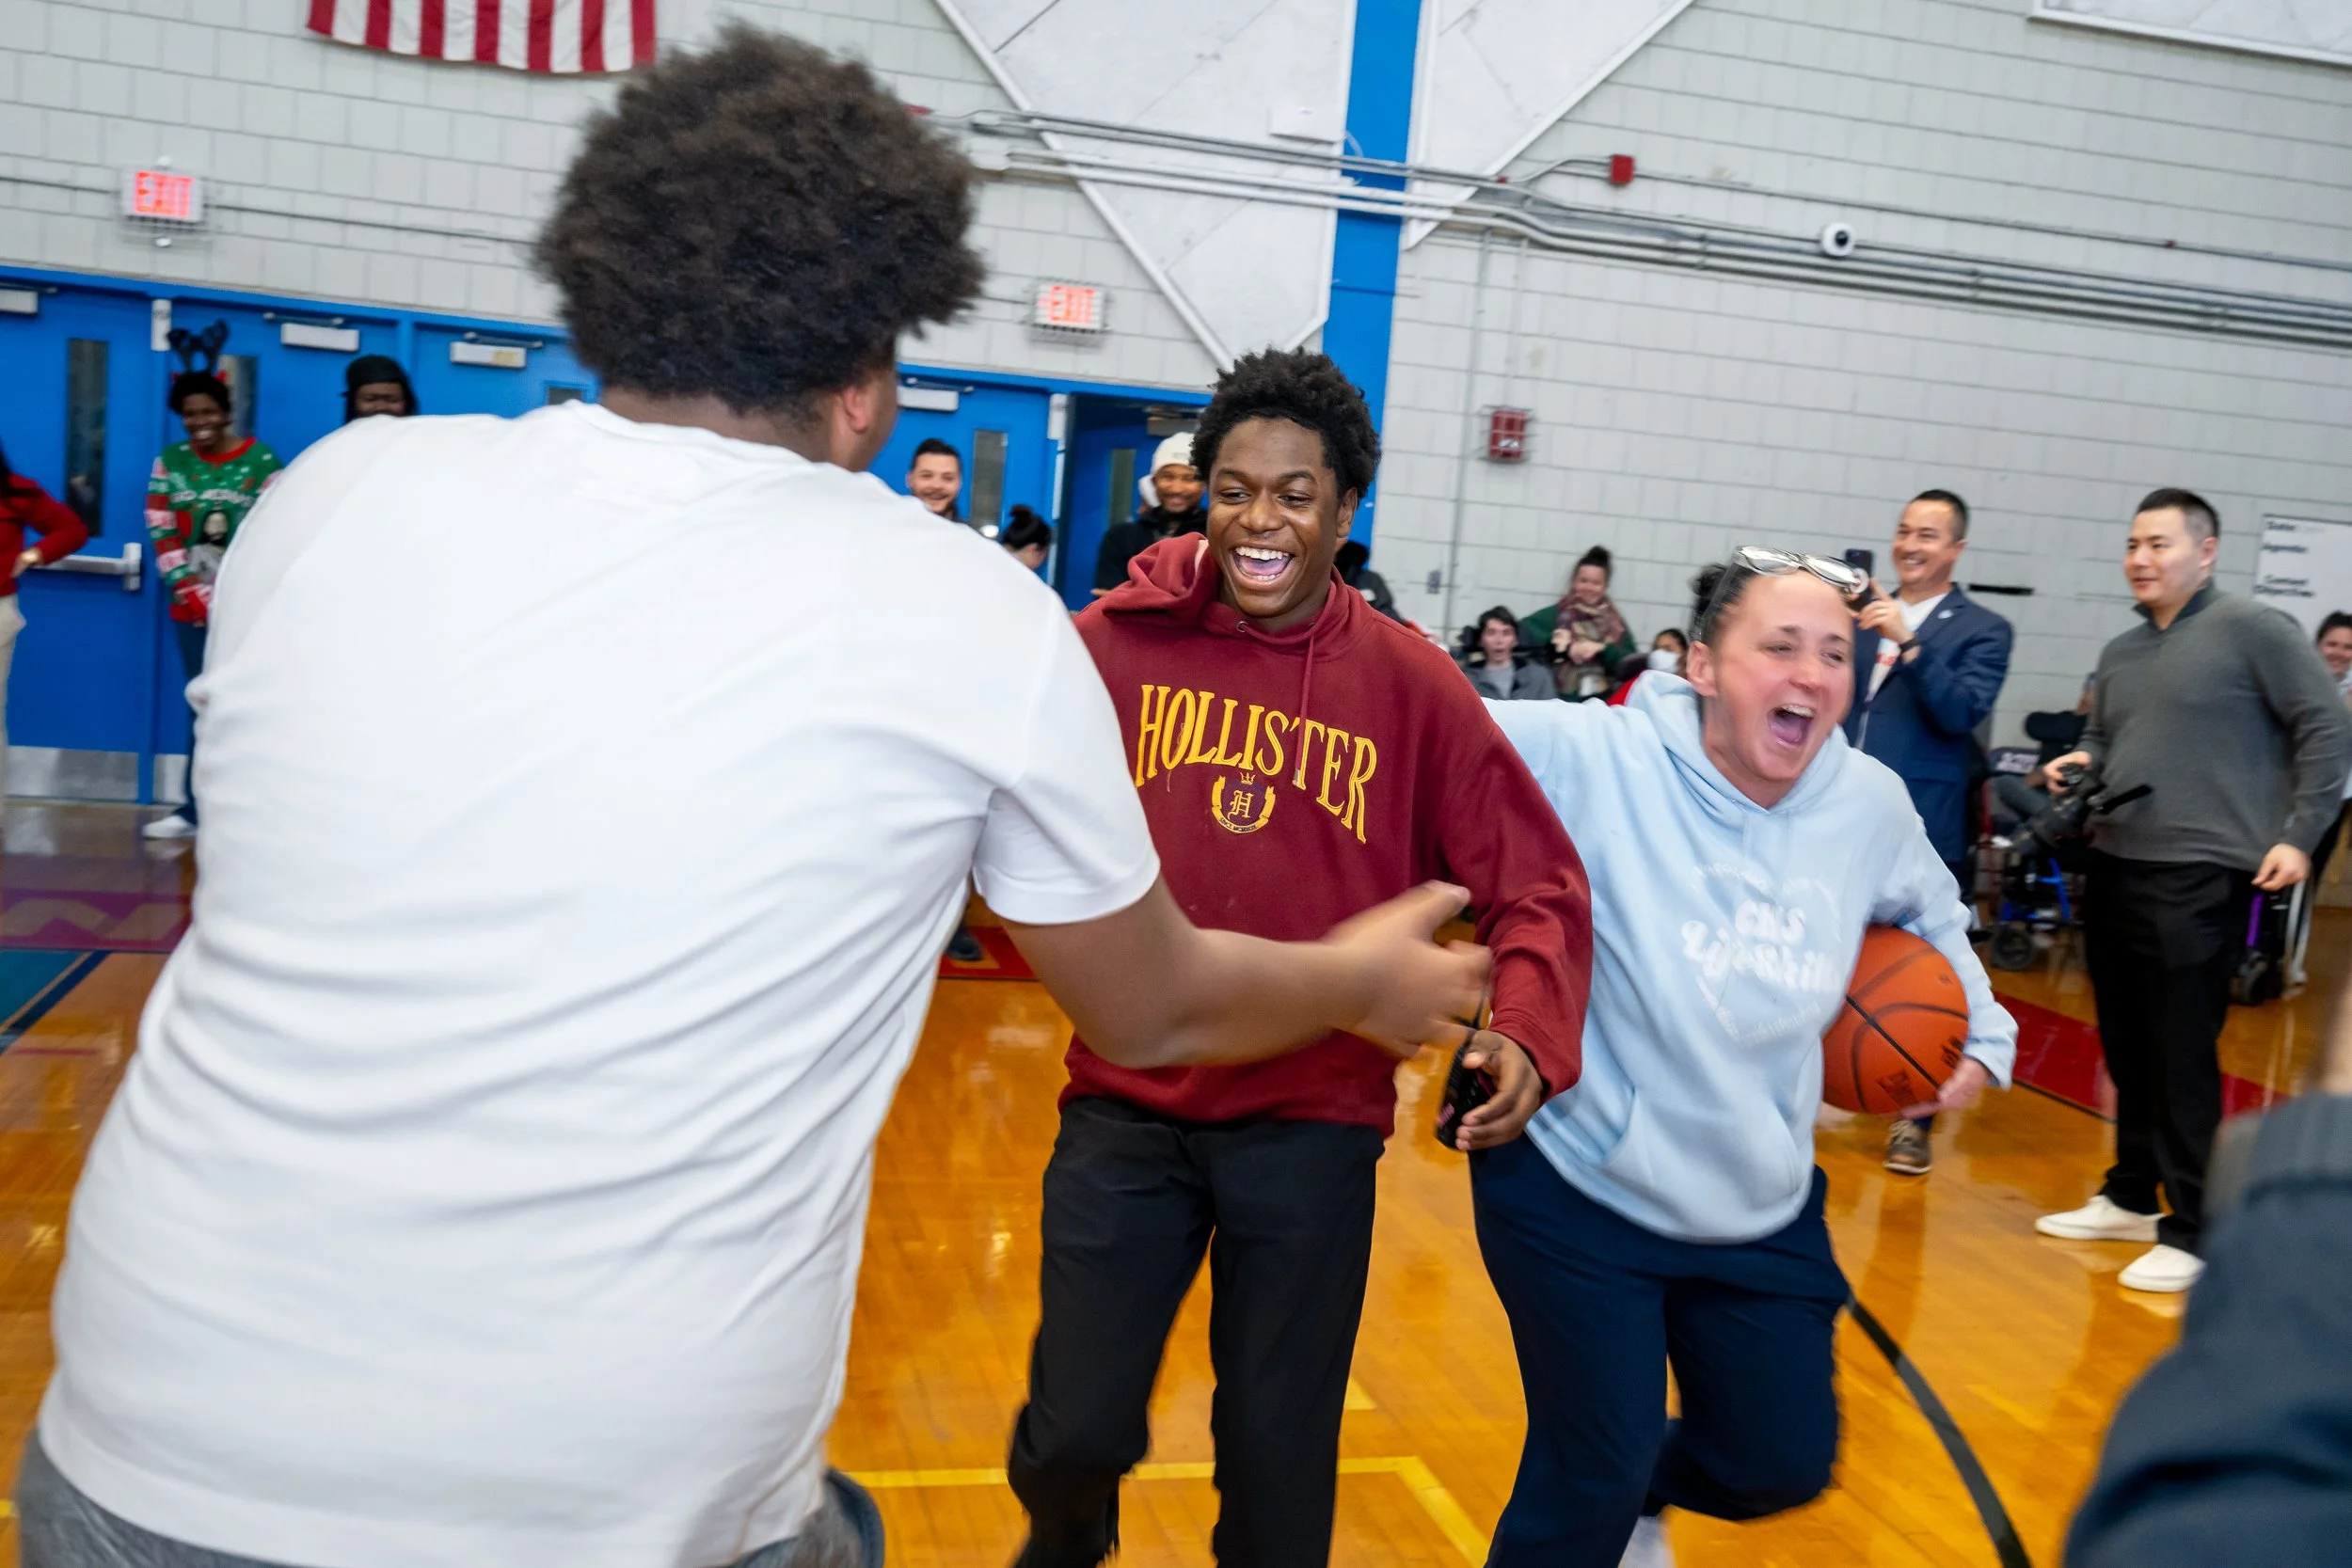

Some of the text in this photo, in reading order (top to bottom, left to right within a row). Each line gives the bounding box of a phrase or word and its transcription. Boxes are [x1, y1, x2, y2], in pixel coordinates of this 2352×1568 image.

[135, 171, 194, 217] EXIT
[1050, 285, 1095, 324] EXIT
[1135, 684, 1377, 845] HOLLISTER
